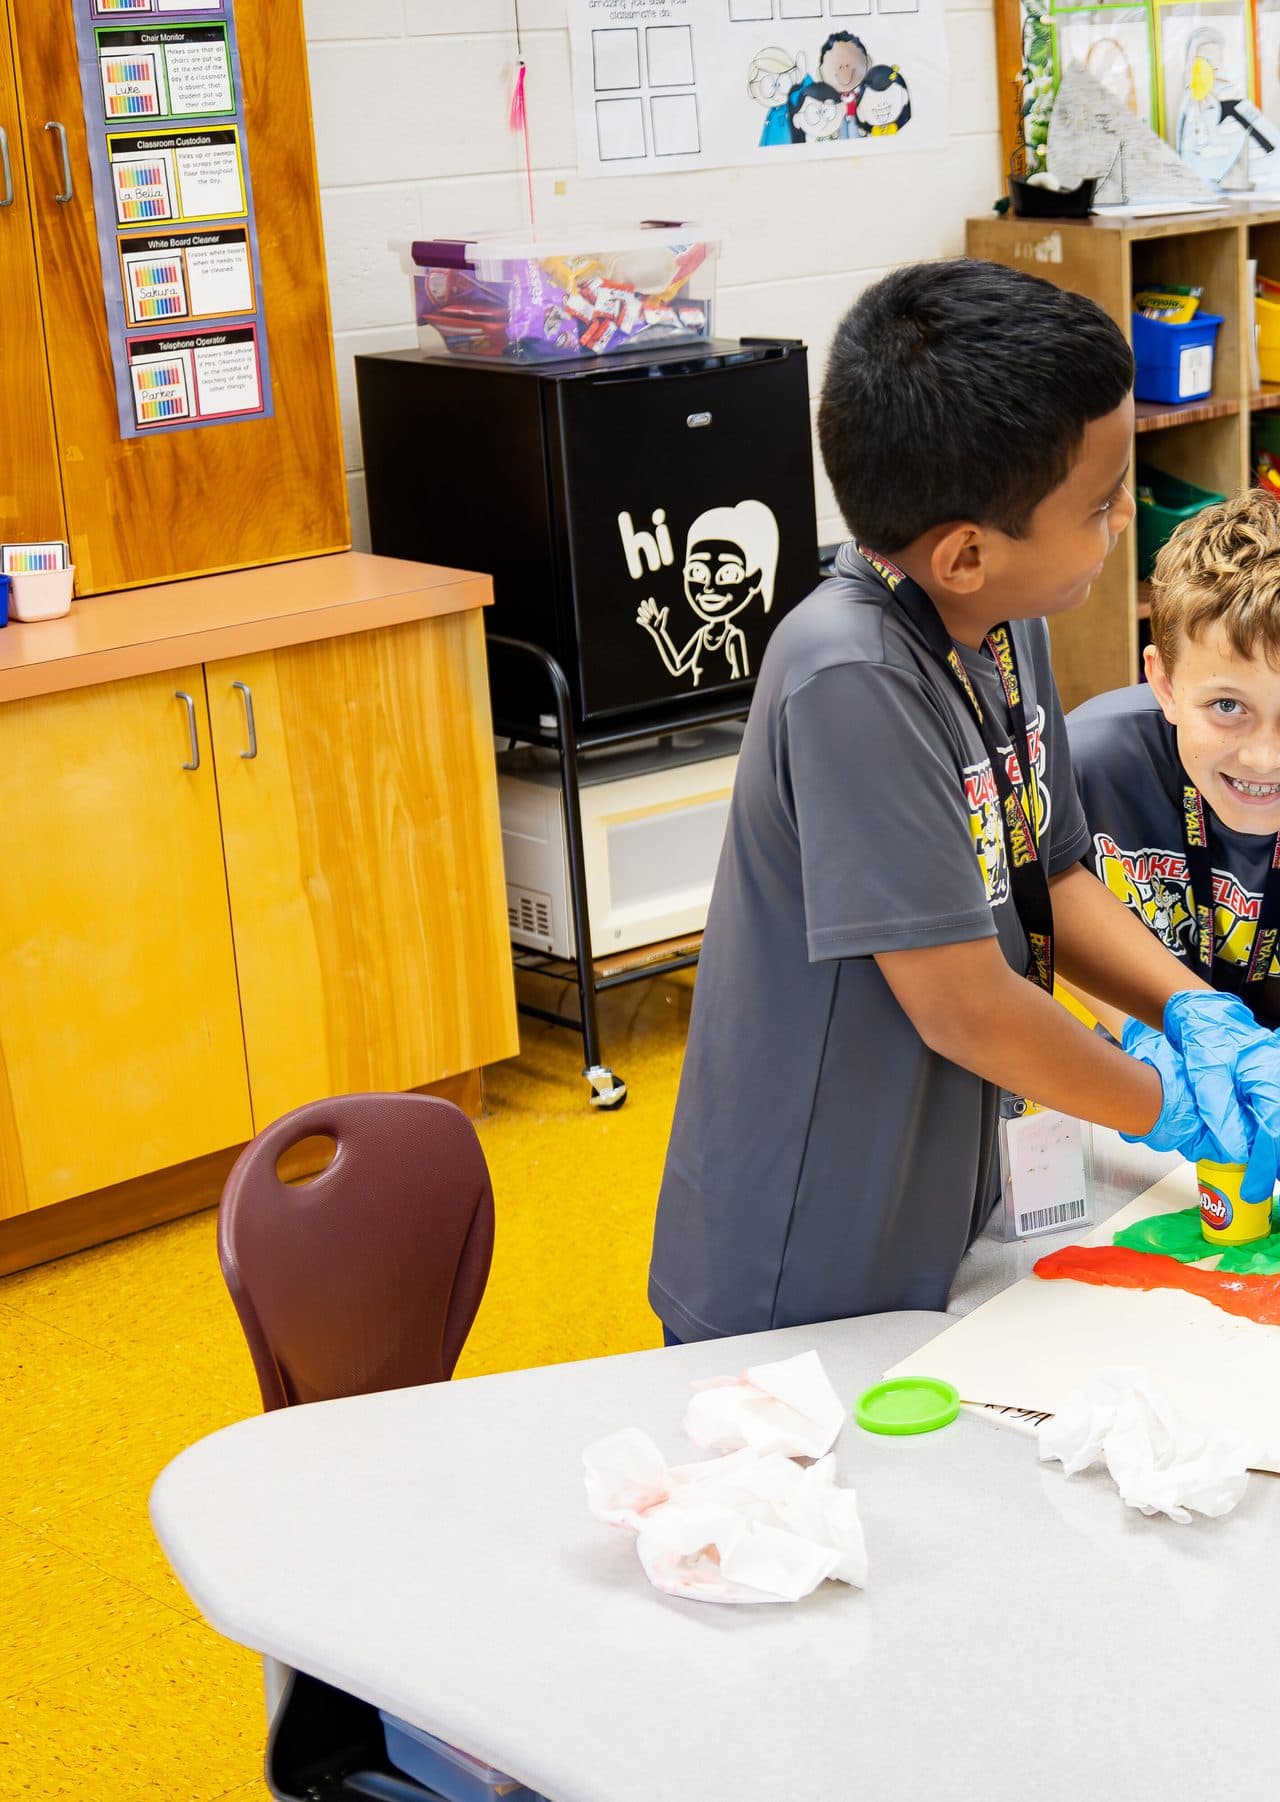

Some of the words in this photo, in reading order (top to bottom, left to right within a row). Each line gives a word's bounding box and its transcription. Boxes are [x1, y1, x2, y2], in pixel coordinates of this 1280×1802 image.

[141, 33, 159, 42] Chair
[160, 32, 185, 41] Monitor
[115, 83, 141, 96] Luke
[137, 140, 175, 149] Classroom
[175, 136, 211, 146] Custodian
[148, 239, 169, 249] White
[170, 237, 191, 247] Board
[192, 235, 220, 245] Cleaner
[140, 286, 178, 298] Sakura
[158, 339, 195, 351] Telephone
[195, 335, 227, 346] Operator
[141, 388, 176, 401] Parker
[617, 507, 676, 581] hi
[1200, 1192, 1226, 1218] -Doh
